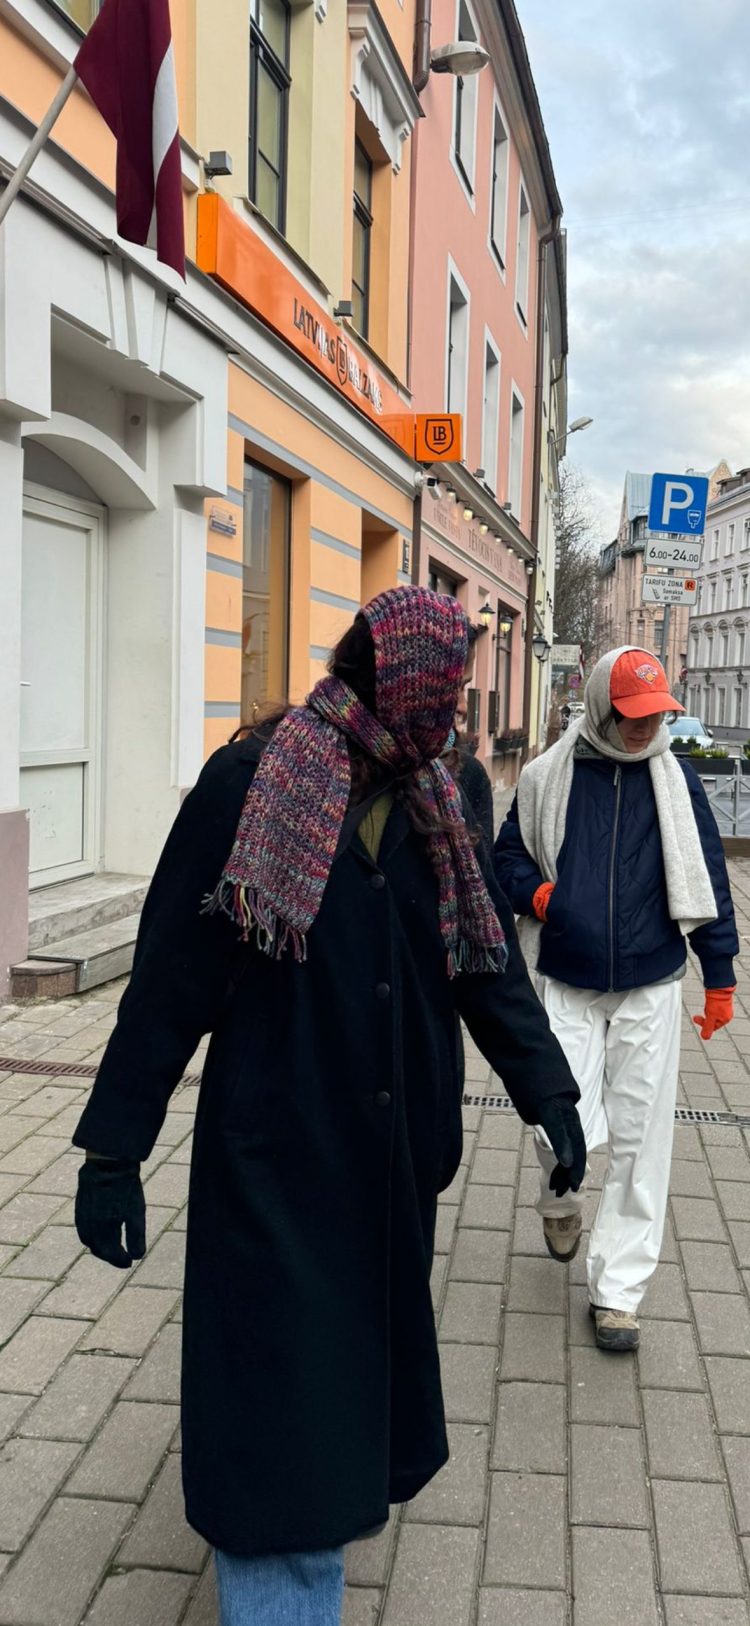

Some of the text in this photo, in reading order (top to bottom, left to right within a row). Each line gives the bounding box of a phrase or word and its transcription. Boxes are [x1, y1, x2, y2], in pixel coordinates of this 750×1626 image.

[433, 425, 447, 441] LB
[661, 480, 694, 525] P
[649, 546, 699, 563] 6.00-24.00
[667, 580, 683, 588] ZONA
